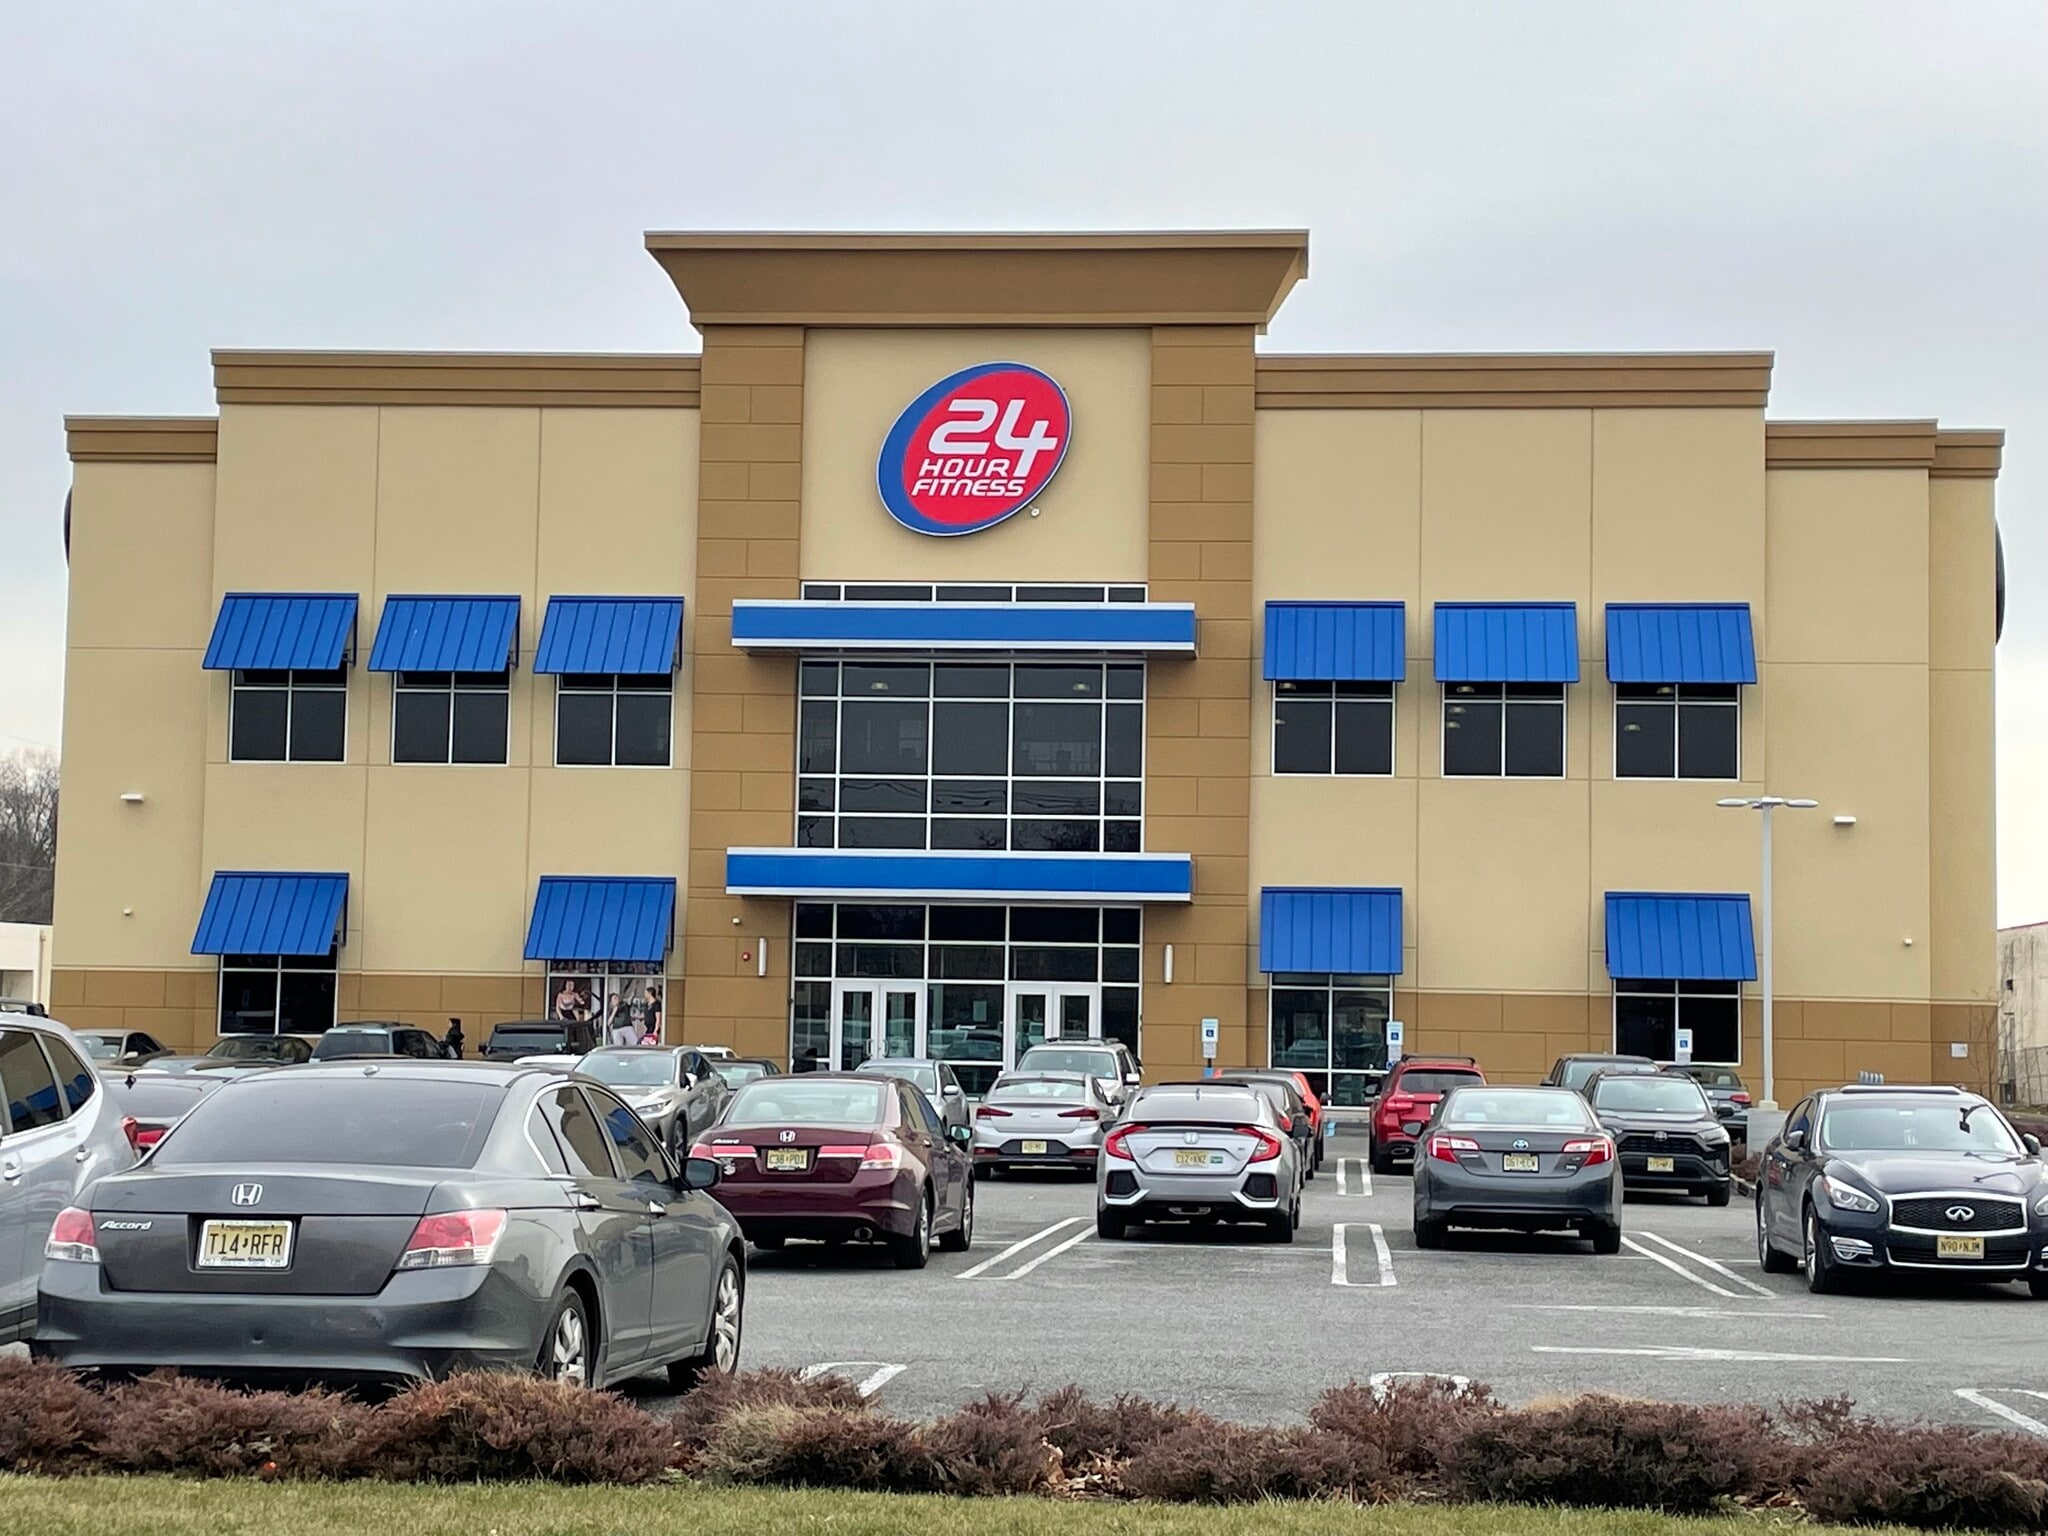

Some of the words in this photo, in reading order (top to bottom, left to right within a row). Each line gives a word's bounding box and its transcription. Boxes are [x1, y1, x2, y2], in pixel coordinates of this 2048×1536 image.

[928, 399, 1058, 477] 24
[919, 458, 1011, 477] HOUR
[911, 478, 1026, 497] FITNESS
[100, 1219, 152, 1231] Accord
